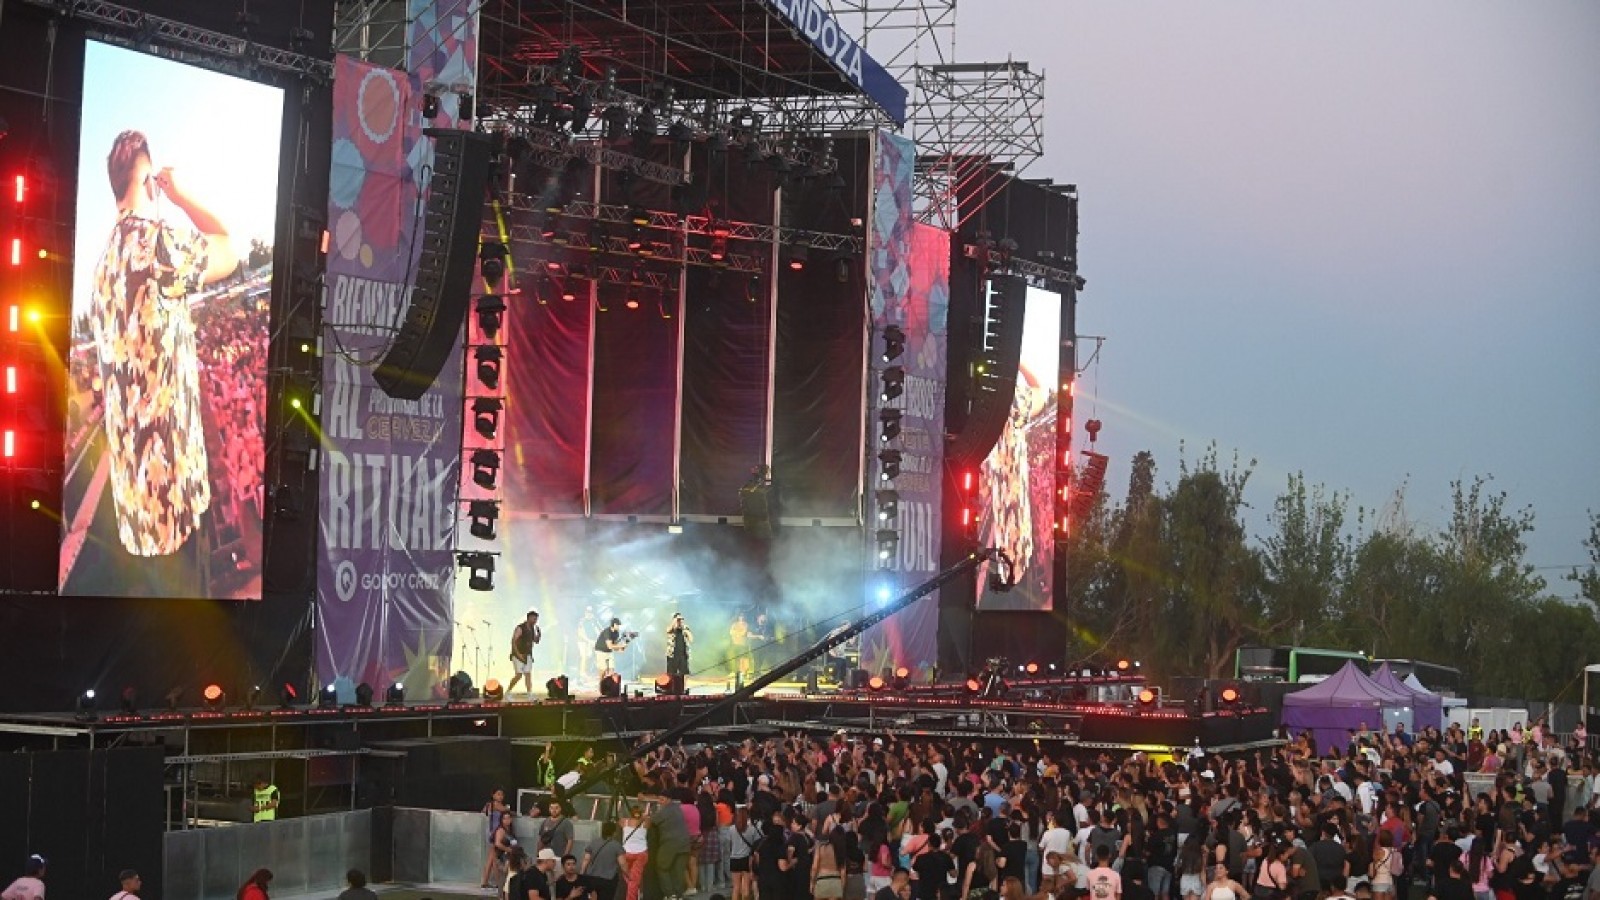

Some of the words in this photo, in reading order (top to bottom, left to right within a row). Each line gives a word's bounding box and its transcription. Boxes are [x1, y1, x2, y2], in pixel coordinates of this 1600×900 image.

[771, 0, 864, 87] NDOZA
[329, 348, 363, 440] AL
[328, 450, 453, 551] RITUAL
[408, 573, 439, 590] CRUZ
